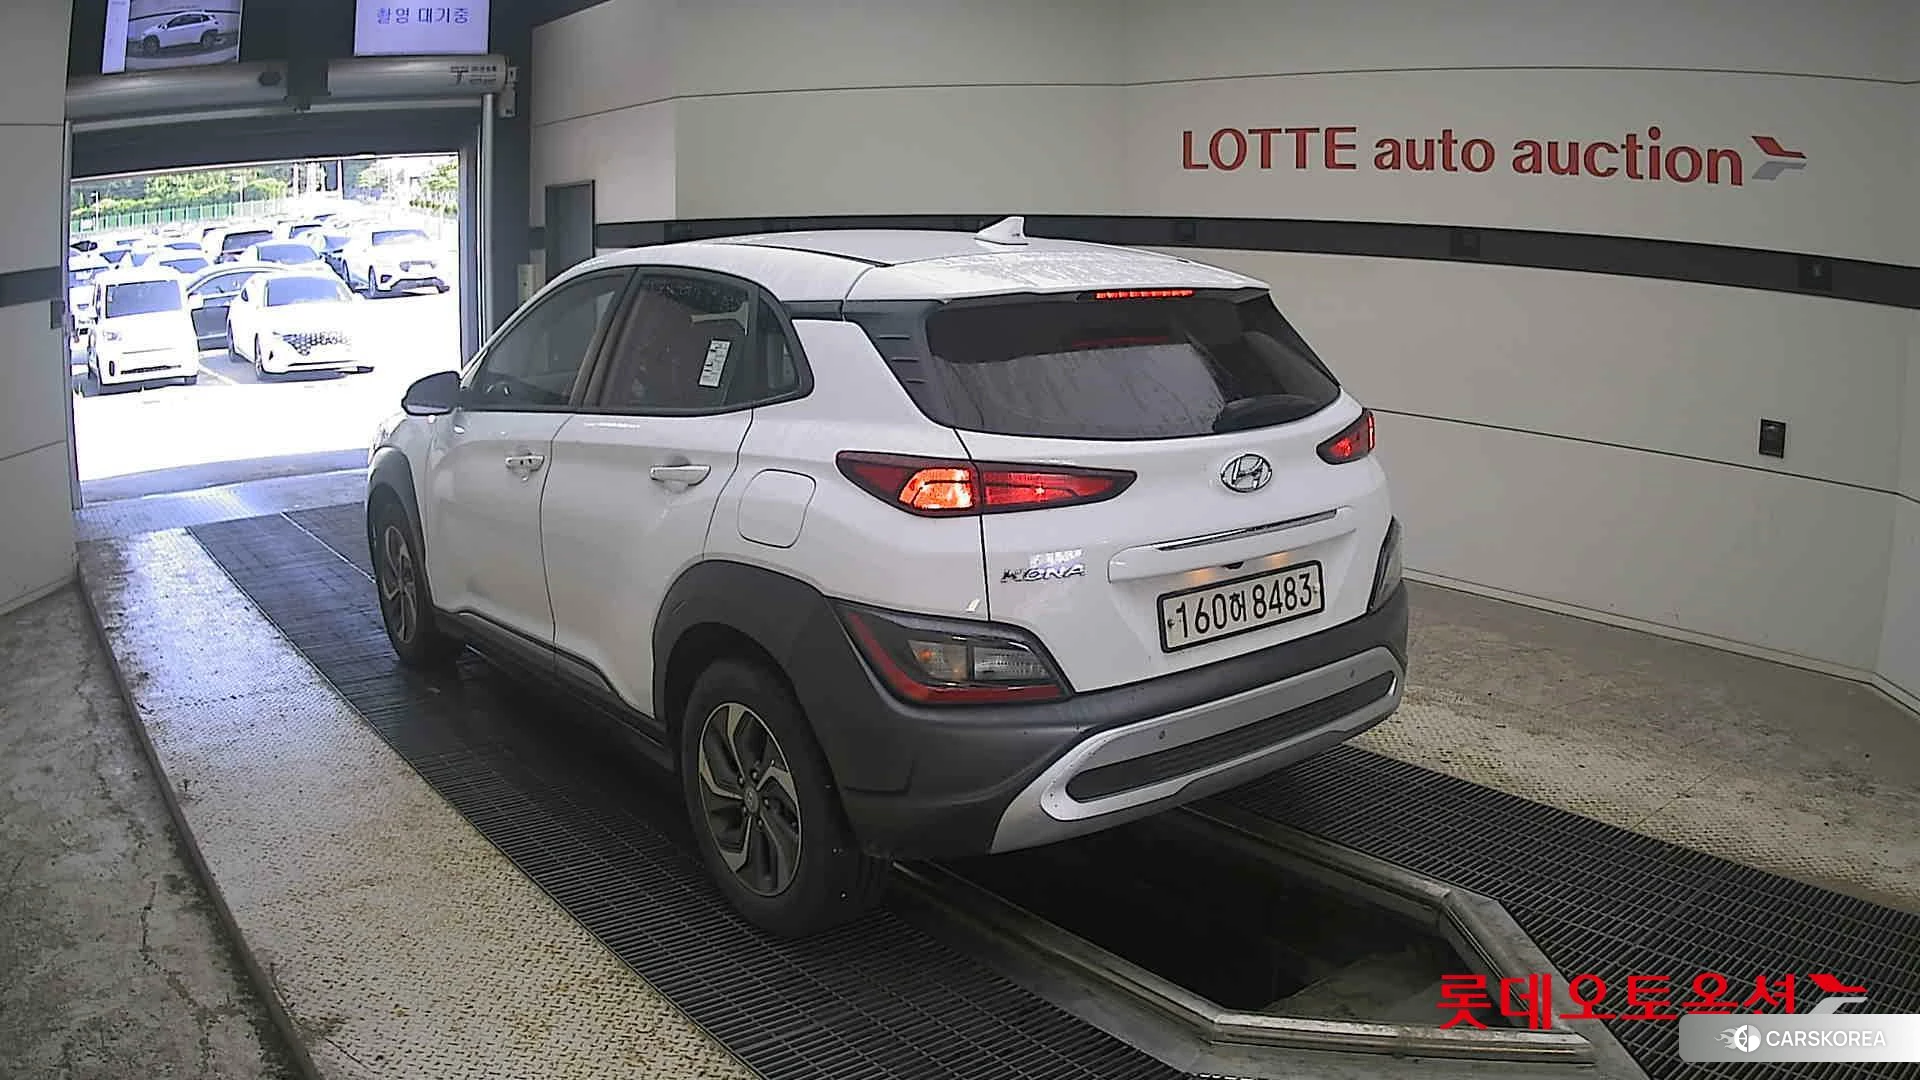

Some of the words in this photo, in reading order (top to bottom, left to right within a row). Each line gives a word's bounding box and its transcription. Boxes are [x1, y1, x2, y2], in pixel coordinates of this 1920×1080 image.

[418, 7, 469, 24] 대기중
[1182, 126, 1358, 171] LOTTE
[1374, 129, 1496, 172] auto
[1512, 126, 1744, 186] auction
[1000, 563, 1087, 584] KONA
[1175, 590, 1248, 638] 160허
[1252, 572, 1312, 619] 8483
